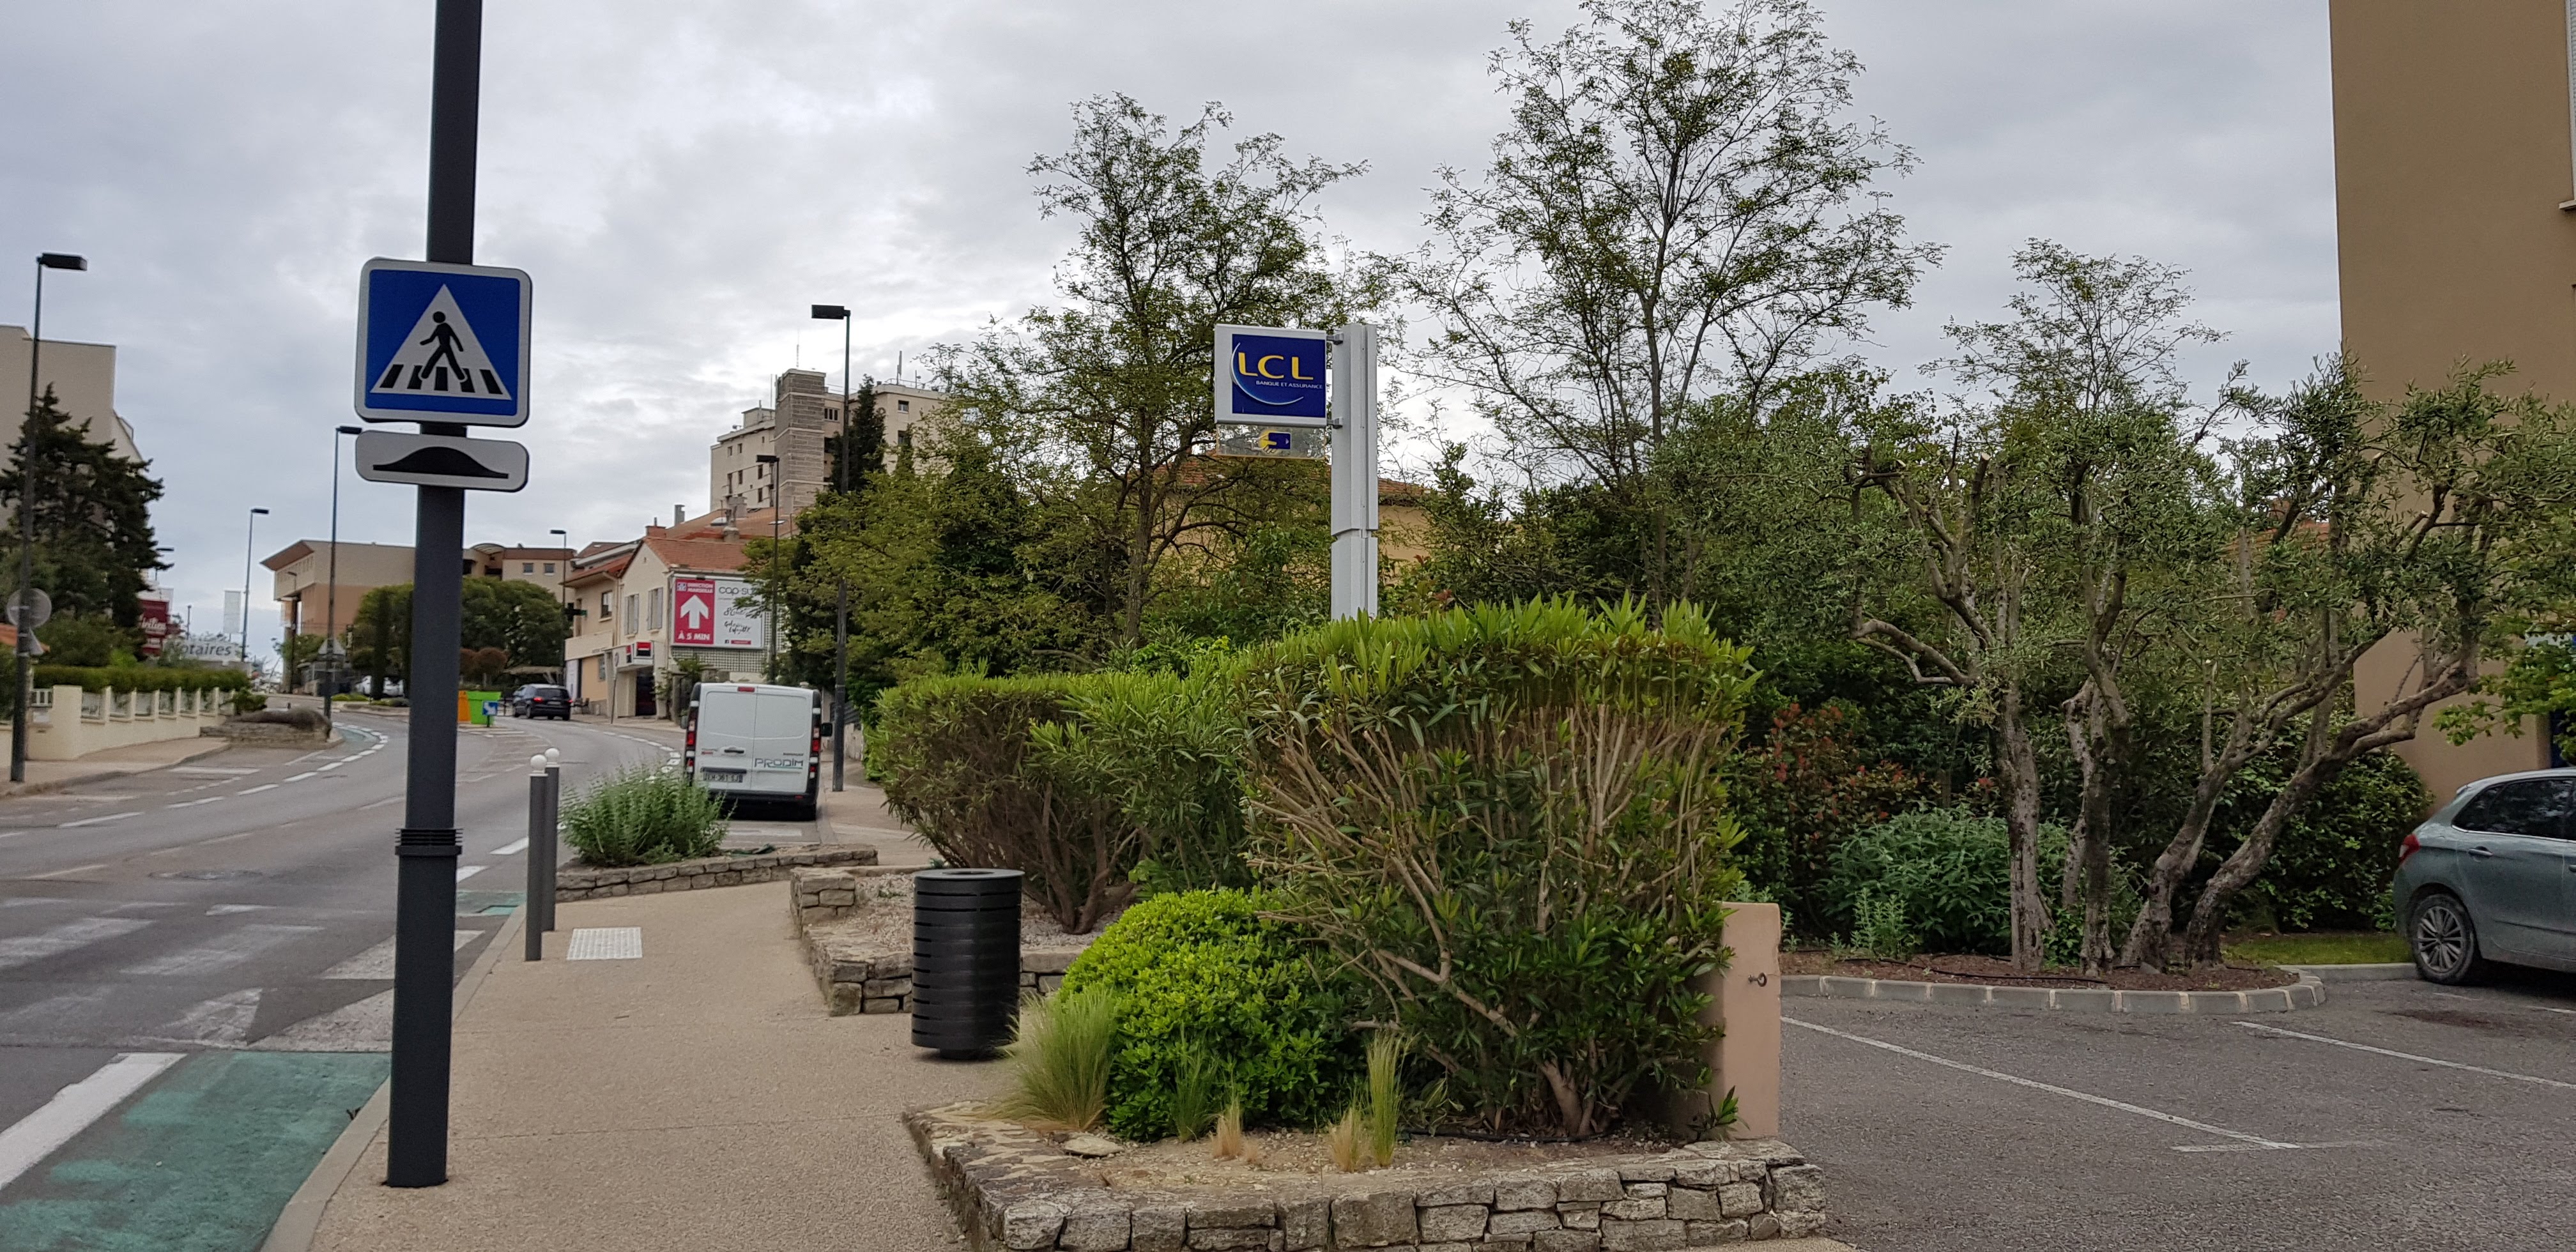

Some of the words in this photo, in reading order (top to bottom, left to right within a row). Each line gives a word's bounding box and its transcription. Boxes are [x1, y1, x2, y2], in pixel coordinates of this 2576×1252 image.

[1238, 352, 1314, 380] LCL
[678, 630, 685, 639] À
[755, 758, 804, 768] PRODIM
